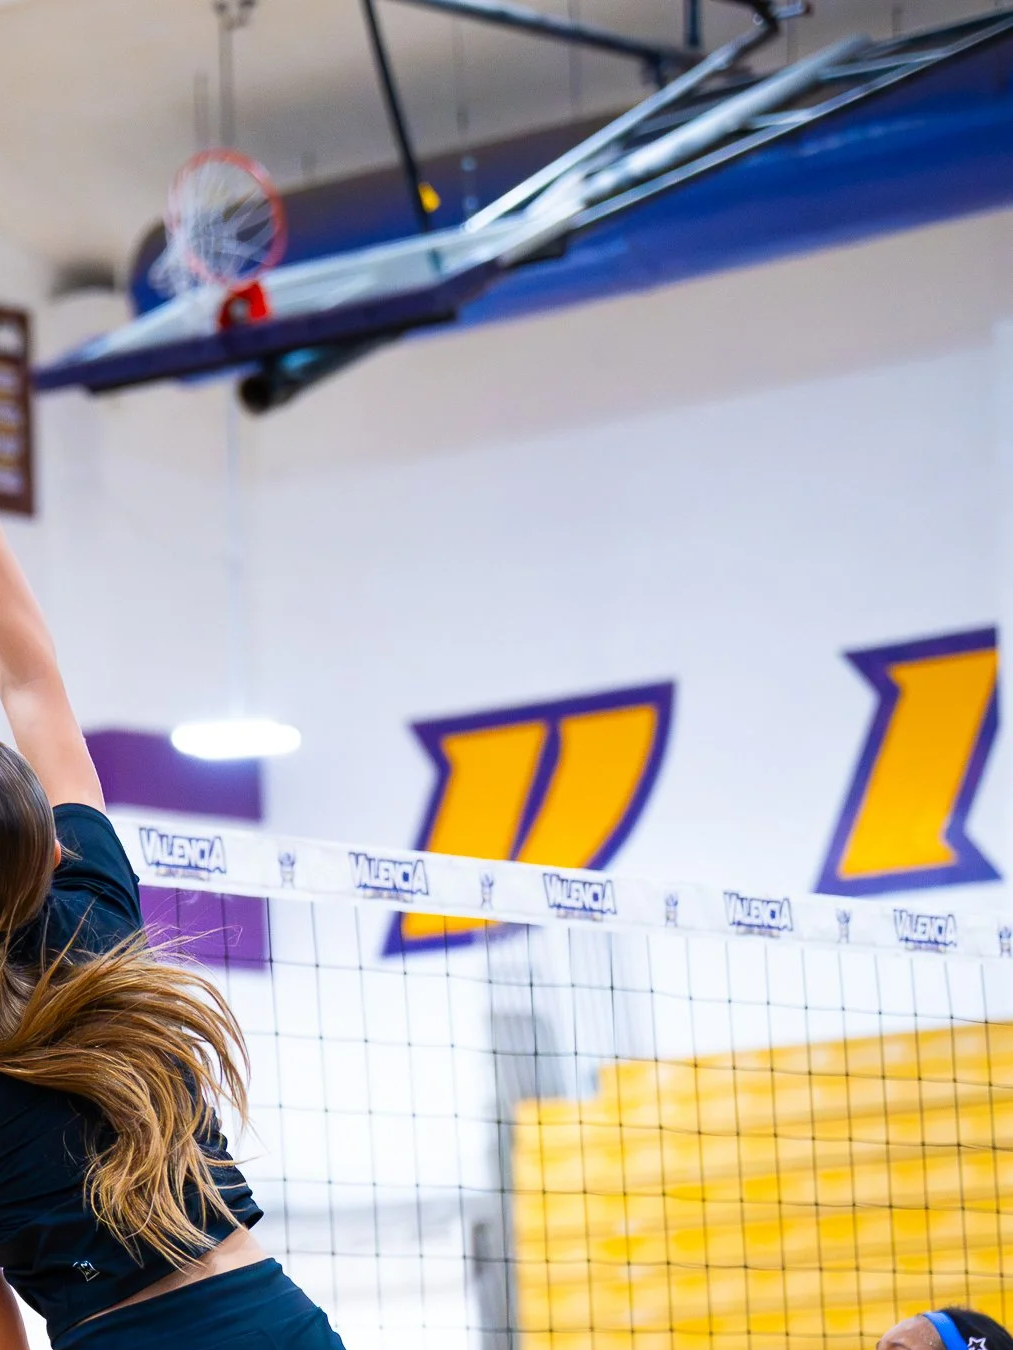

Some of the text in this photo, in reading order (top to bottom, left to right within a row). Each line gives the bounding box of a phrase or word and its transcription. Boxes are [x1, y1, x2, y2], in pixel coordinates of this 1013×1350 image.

[139, 827, 227, 874] VALENCIA
[348, 851, 429, 896] VALENCIA
[543, 873, 617, 915] VALENCIA
[724, 891, 794, 932] VALENCIA
[893, 909, 958, 947] VALENCIA
